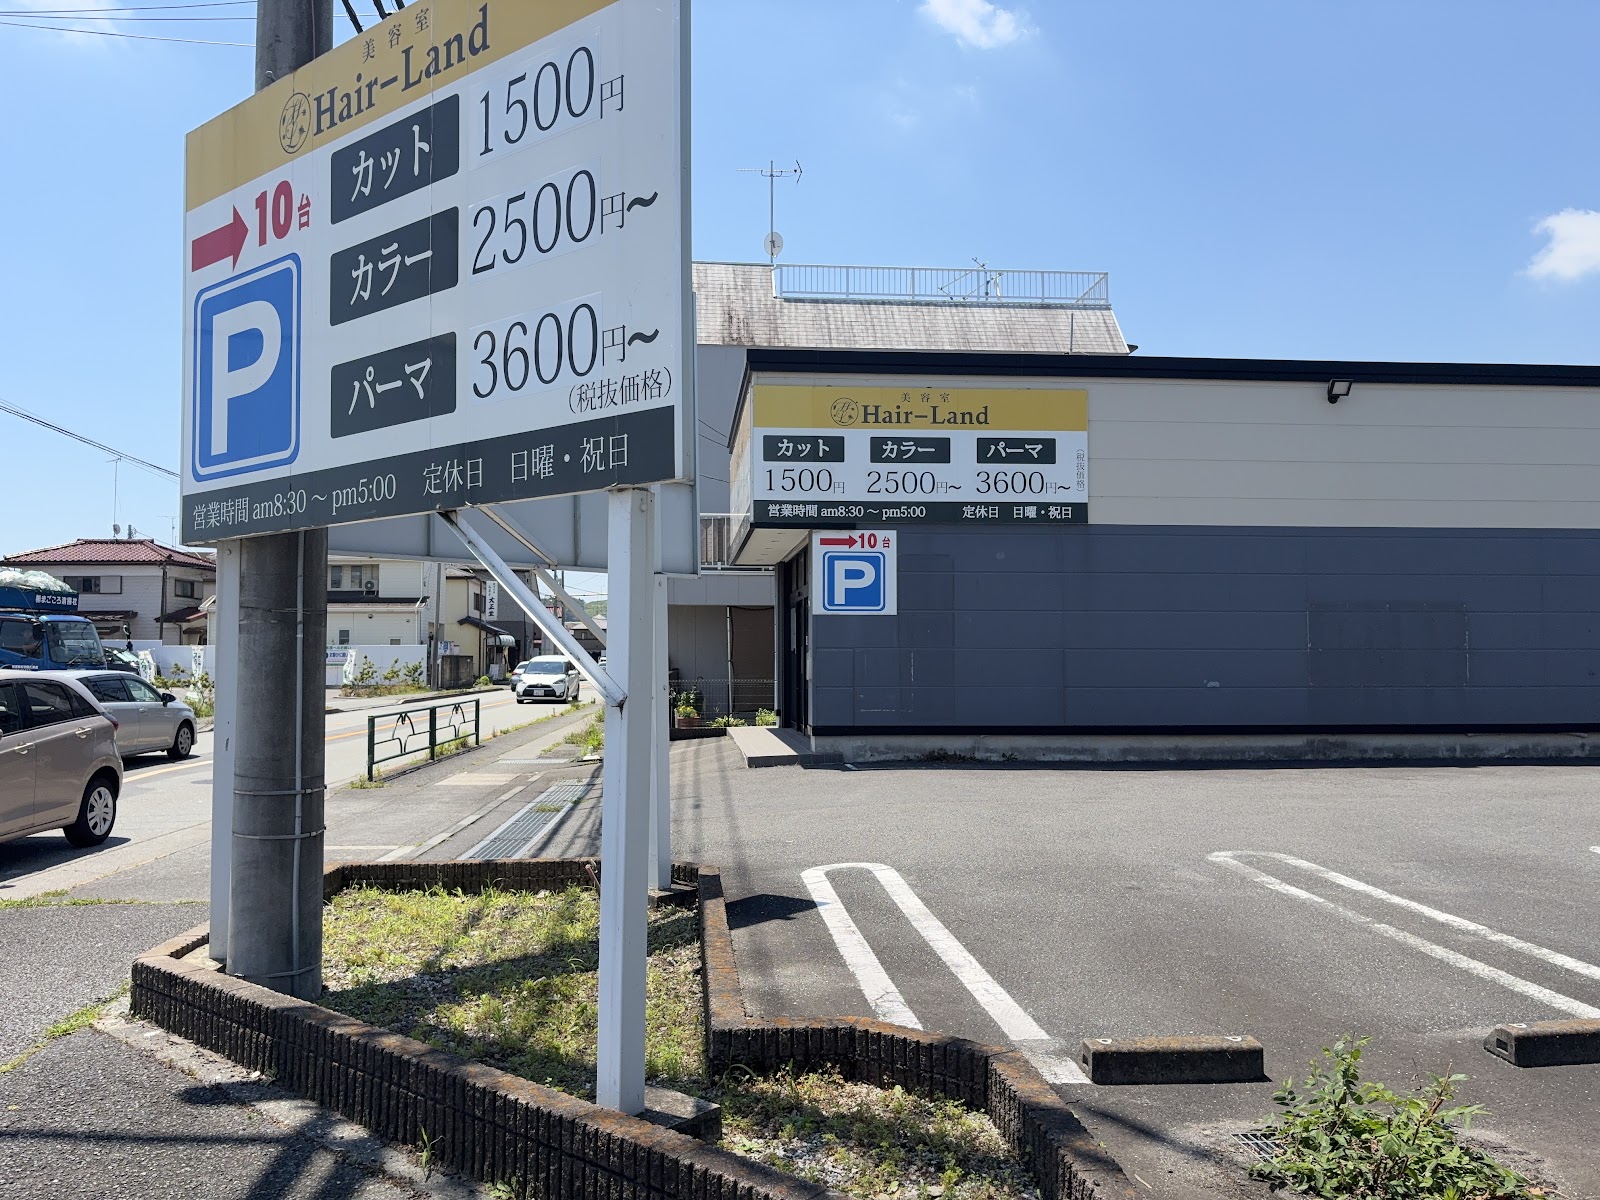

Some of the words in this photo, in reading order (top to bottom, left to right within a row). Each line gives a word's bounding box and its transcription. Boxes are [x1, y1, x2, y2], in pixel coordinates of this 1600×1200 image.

[362, 8, 430, 64] 美容室
[313, 2, 490, 137] Hair-Land
[350, 124, 432, 203] カット
[350, 242, 433, 305] カラー
[210, 300, 282, 457] P
[347, 357, 433, 416] パーマ
[901, 392, 950, 403] 美容室
[861, 404, 989, 425] Hair-Land
[777, 438, 830, 458] カット
[881, 440, 935, 459] カラー
[986, 441, 1043, 459] パーマ
[192, 496, 250, 530] 営業時間
[422, 457, 483, 497] 定休日
[510, 433, 629, 484] 日曜・祝日
[767, 504, 818, 518] 営業時間
[962, 505, 999, 519] 定休日
[1013, 505, 1072, 519] 日曜・祝日
[833, 560, 876, 605] P
